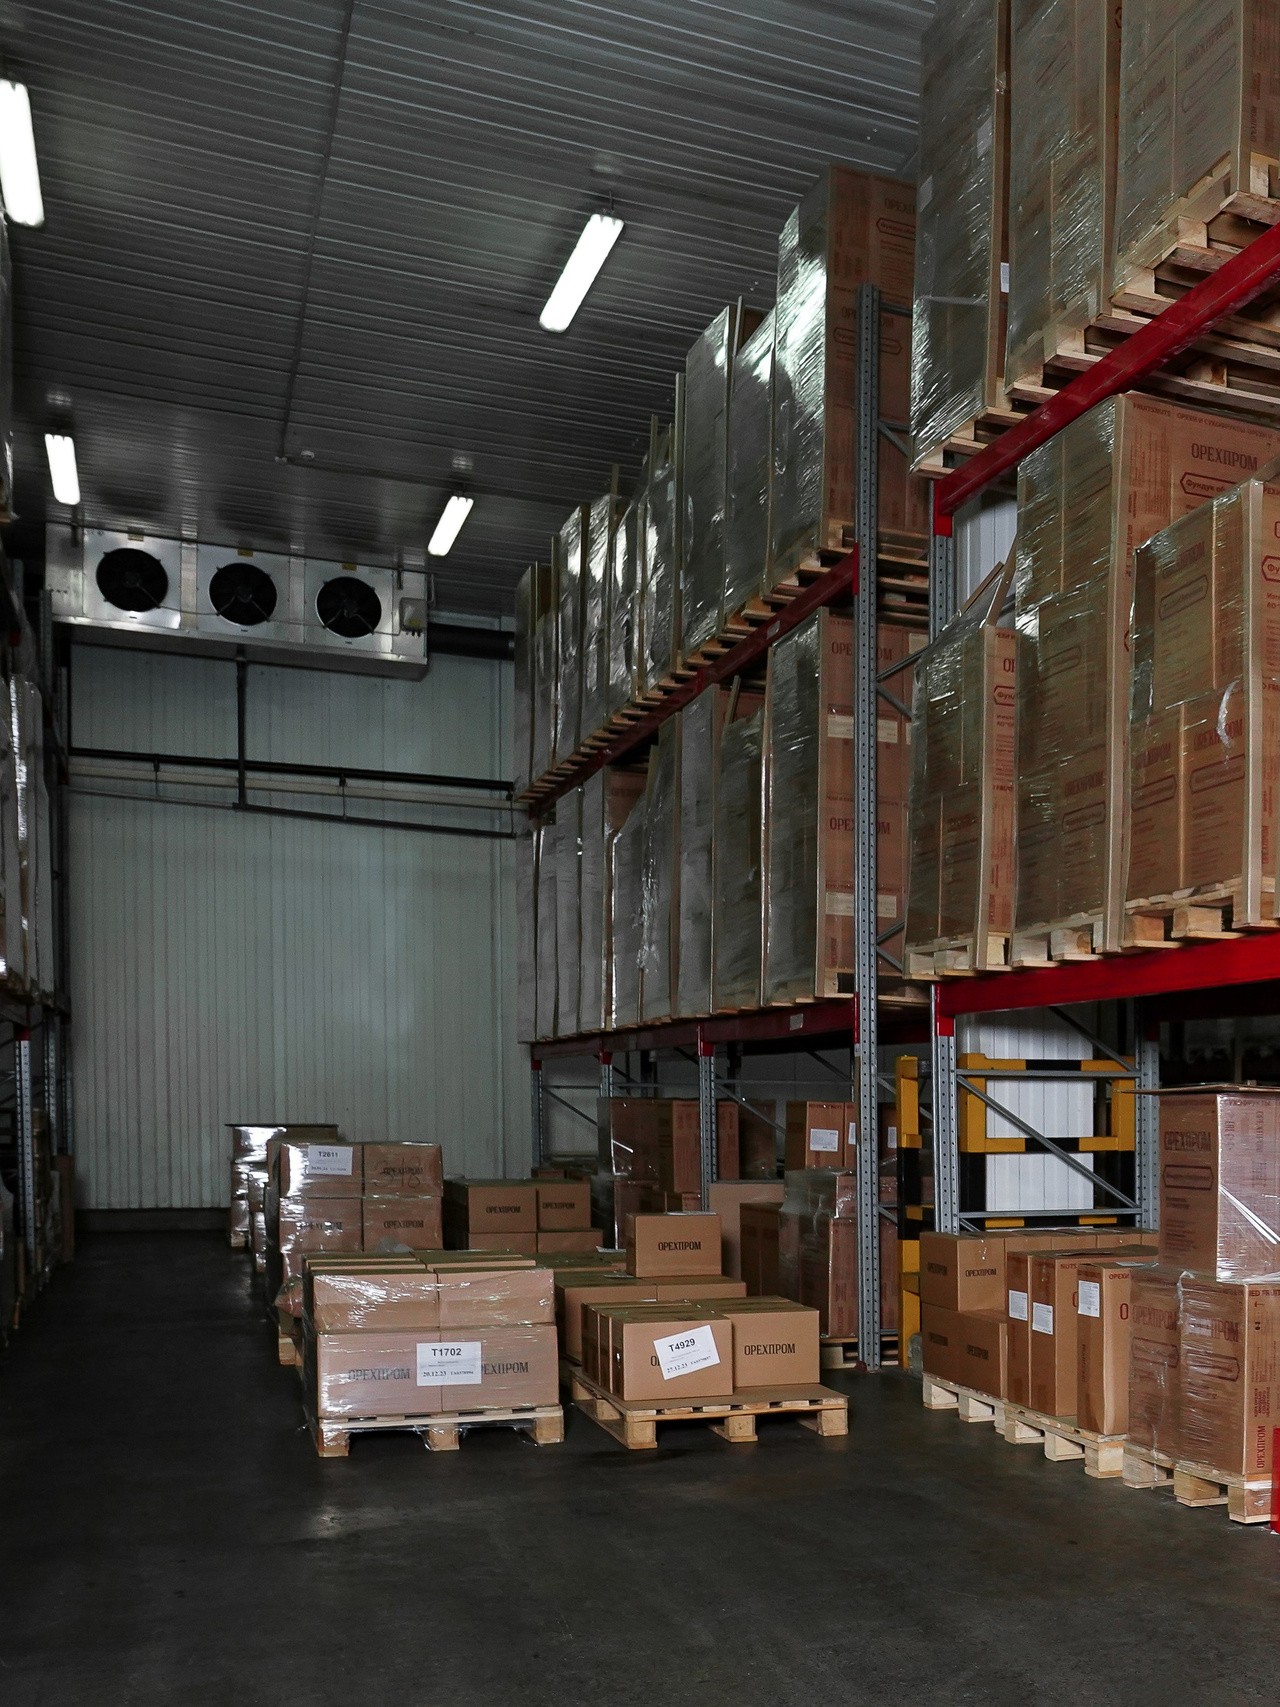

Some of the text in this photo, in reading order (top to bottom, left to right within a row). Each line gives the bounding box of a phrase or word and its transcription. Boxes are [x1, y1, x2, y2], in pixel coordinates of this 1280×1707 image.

[1191, 442, 1258, 472] ОРЕХПРОМ
[485, 1206, 521, 1214] ОРЕХПРОМ
[383, 1219, 424, 1229] ОРЕХПРОМ
[657, 1241, 702, 1251] ОРЕХПРОМ
[964, 1268, 997, 1278] ОРЕХПРОМ
[668, 1338, 696, 1353] T4929
[744, 1343, 796, 1356] ОРЕХПРОМ
[431, 1347, 462, 1357] T1702
[348, 1367, 410, 1382] ОРЕХПРОМ
[1256, 1425, 1266, 1469] ОРЕХПРОМ
